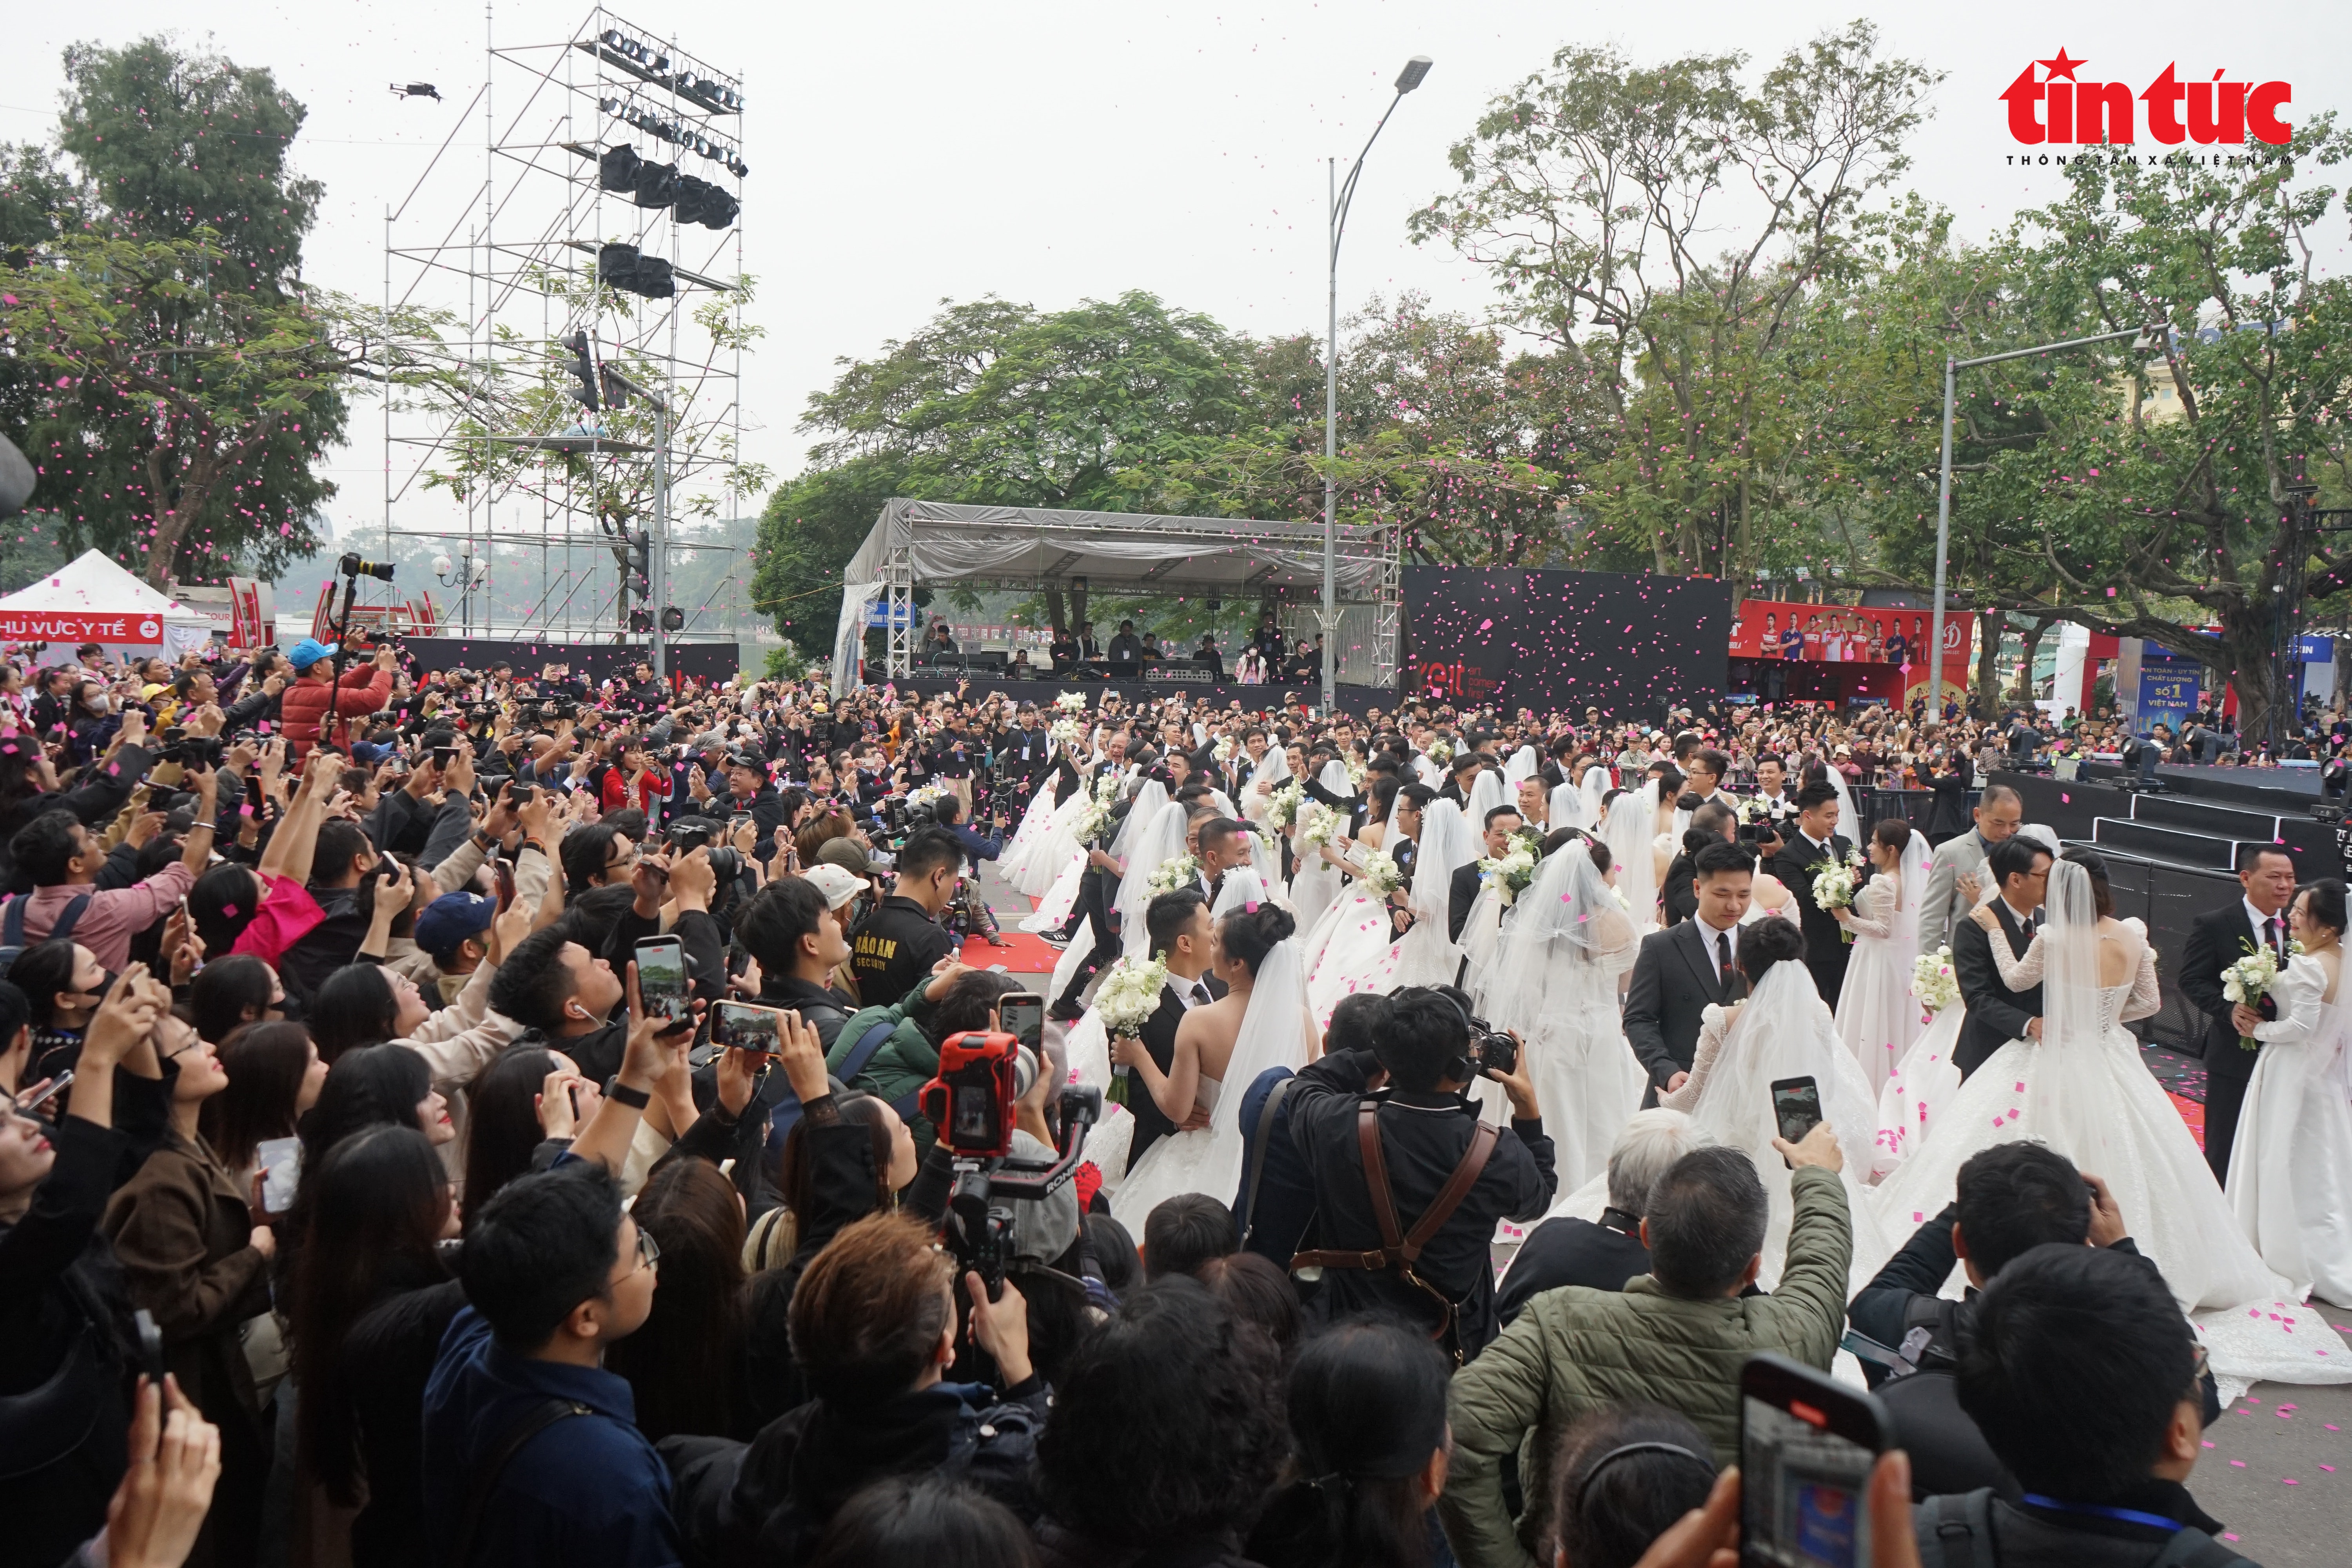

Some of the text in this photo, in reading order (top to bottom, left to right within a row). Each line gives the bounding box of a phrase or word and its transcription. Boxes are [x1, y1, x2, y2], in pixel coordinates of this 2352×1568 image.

[0, 618, 126, 638] HU VỰC Y TẾ
[1468, 677, 1497, 689] comes
[1468, 687, 1485, 700] first
[2155, 684, 2181, 698] SỐ 1
[2148, 699, 2166, 708] VIỆT
[855, 930, 897, 959] BẢO AN
[857, 957, 886, 971] SECURITY
[1047, 1158, 1078, 1194] RONIN
